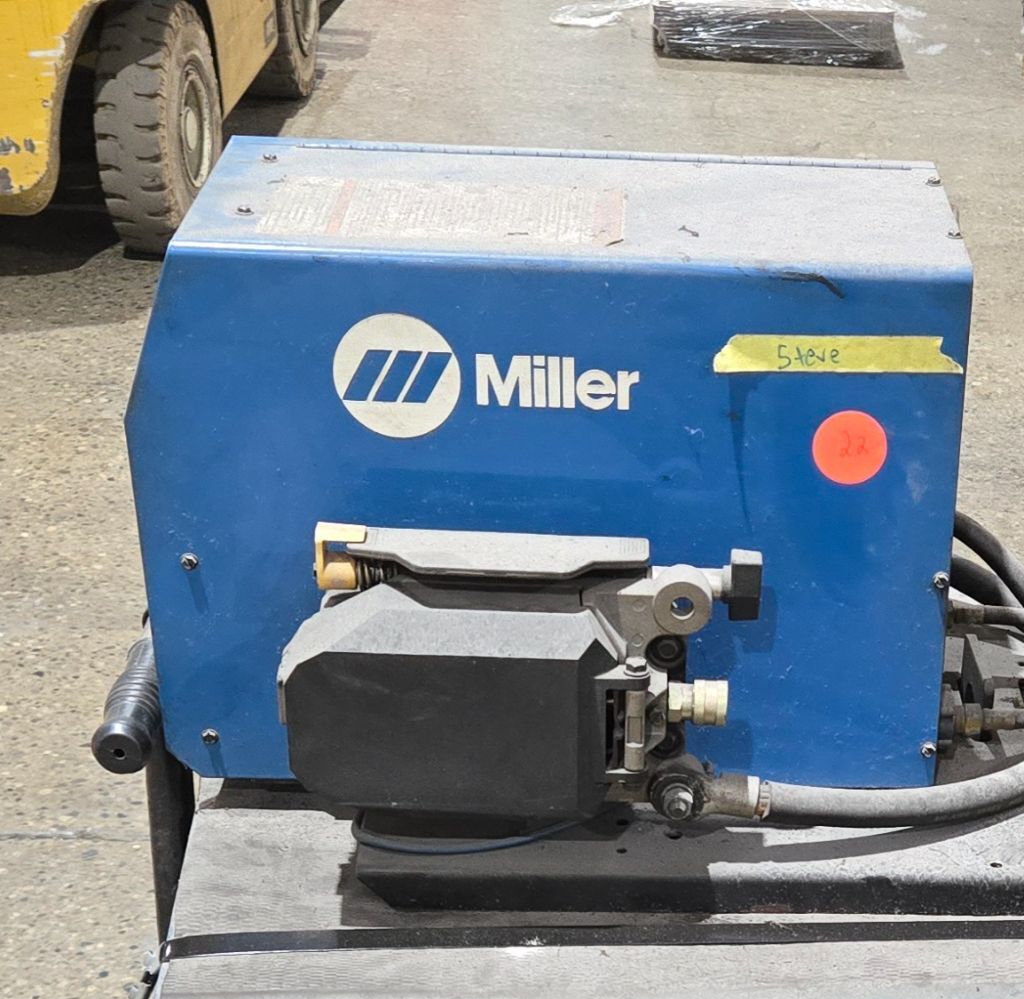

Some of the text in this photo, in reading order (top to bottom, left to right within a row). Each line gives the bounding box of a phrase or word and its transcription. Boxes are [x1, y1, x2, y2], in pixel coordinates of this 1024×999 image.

[777, 344, 841, 370] Steve
[475, 353, 640, 411] Miller
[838, 430, 869, 458] 22
